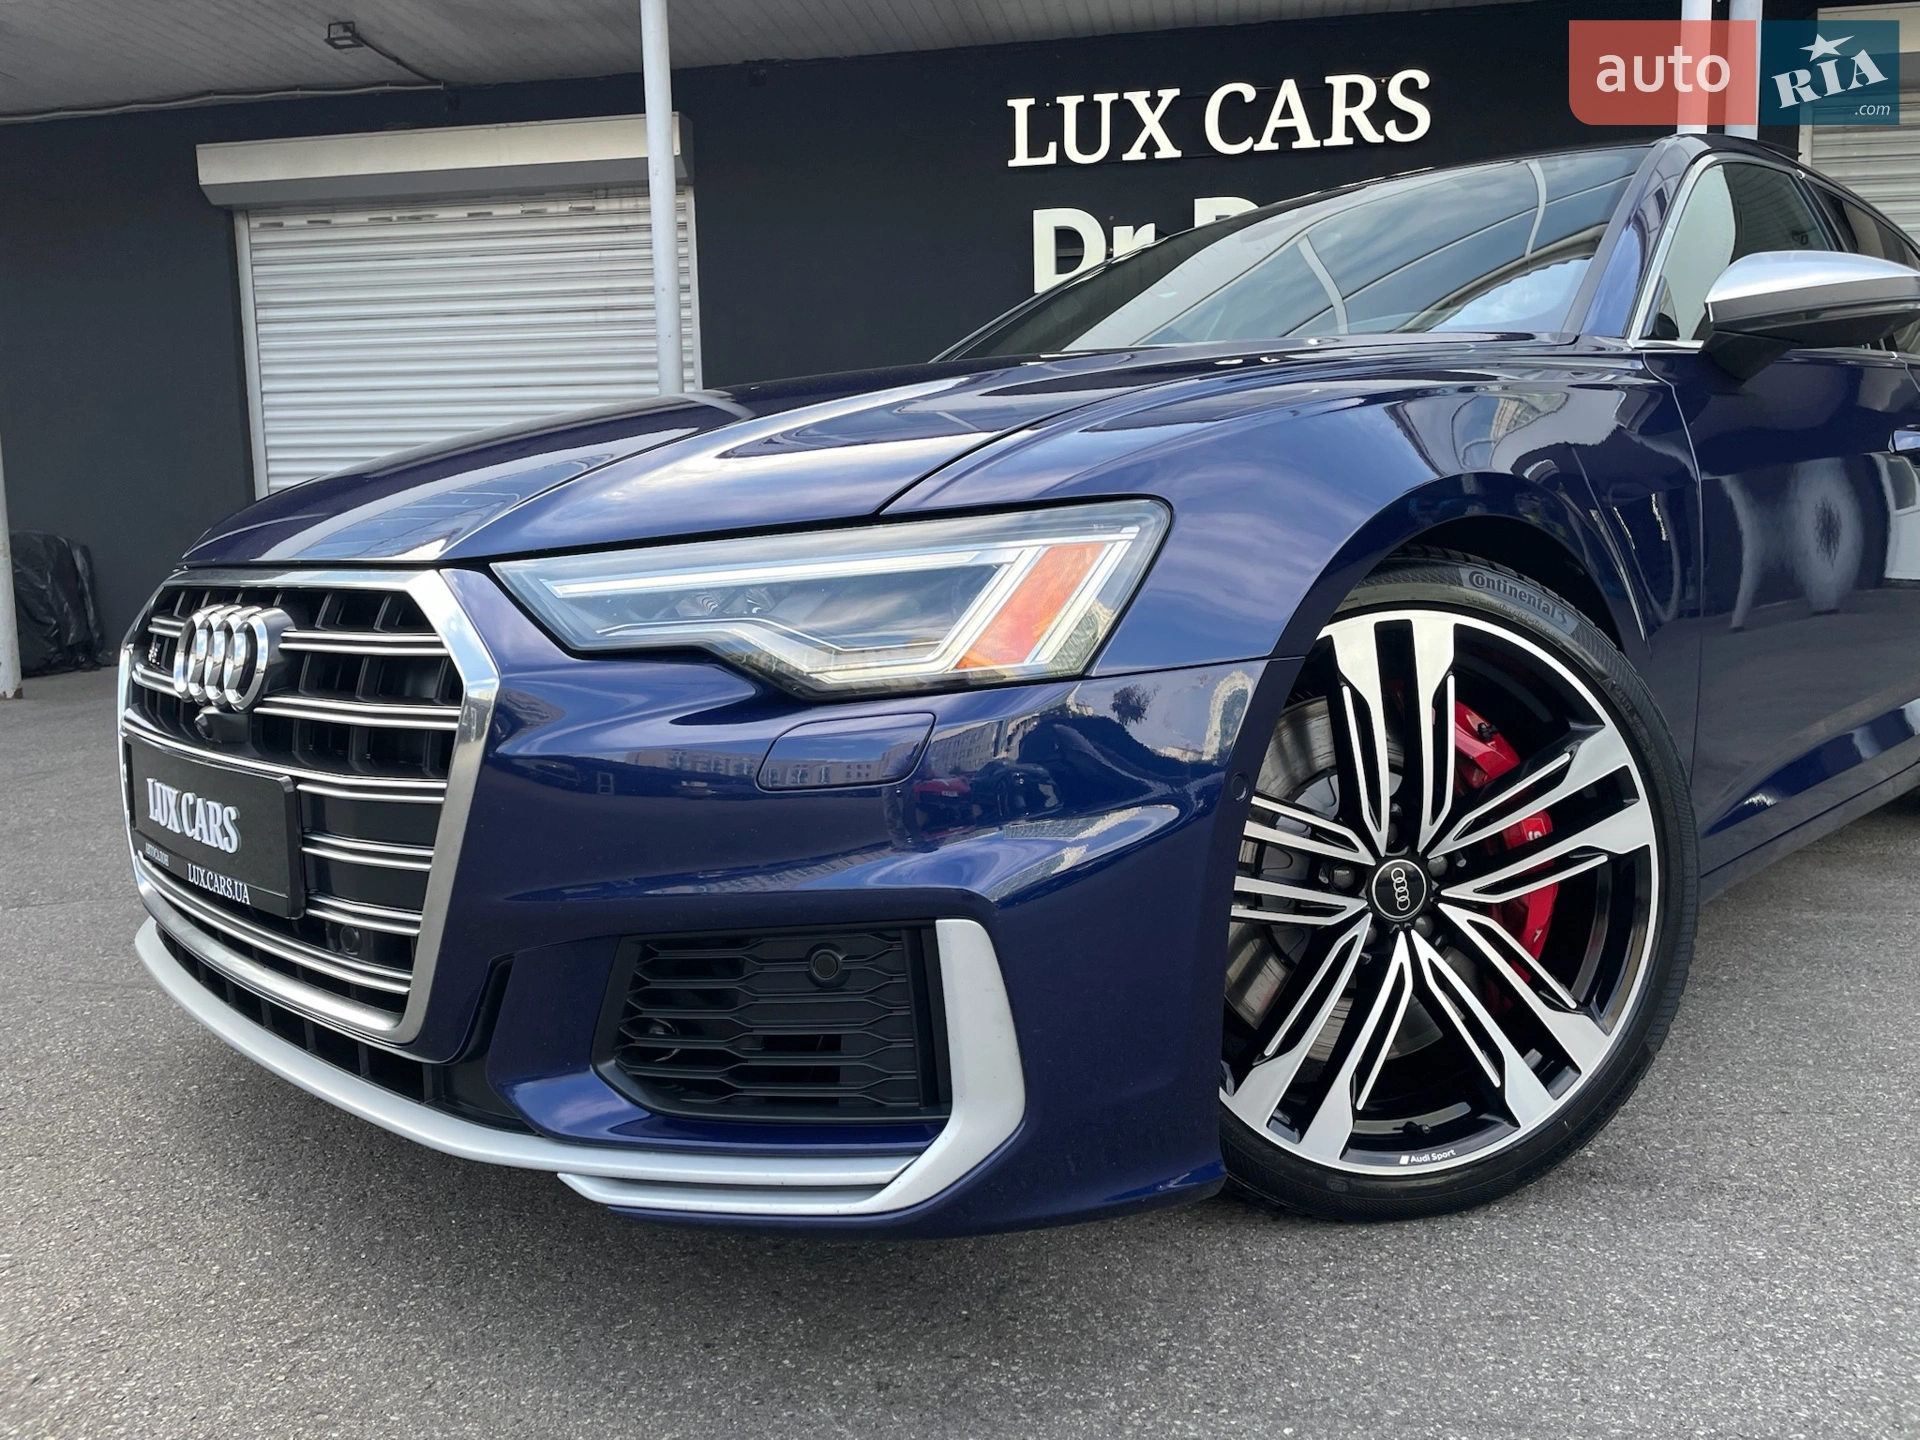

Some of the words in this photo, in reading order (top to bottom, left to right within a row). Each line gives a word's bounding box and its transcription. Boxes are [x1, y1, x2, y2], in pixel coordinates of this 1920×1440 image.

[1007, 87, 1182, 168] LUX
[1204, 69, 1431, 155] CARS
[1469, 571, 1556, 619] Continental
[146, 778, 180, 834] LUX
[181, 792, 241, 854] CARS
[1410, 1154, 1430, 1163] Audi
[1431, 1149, 1456, 1161] Sport
